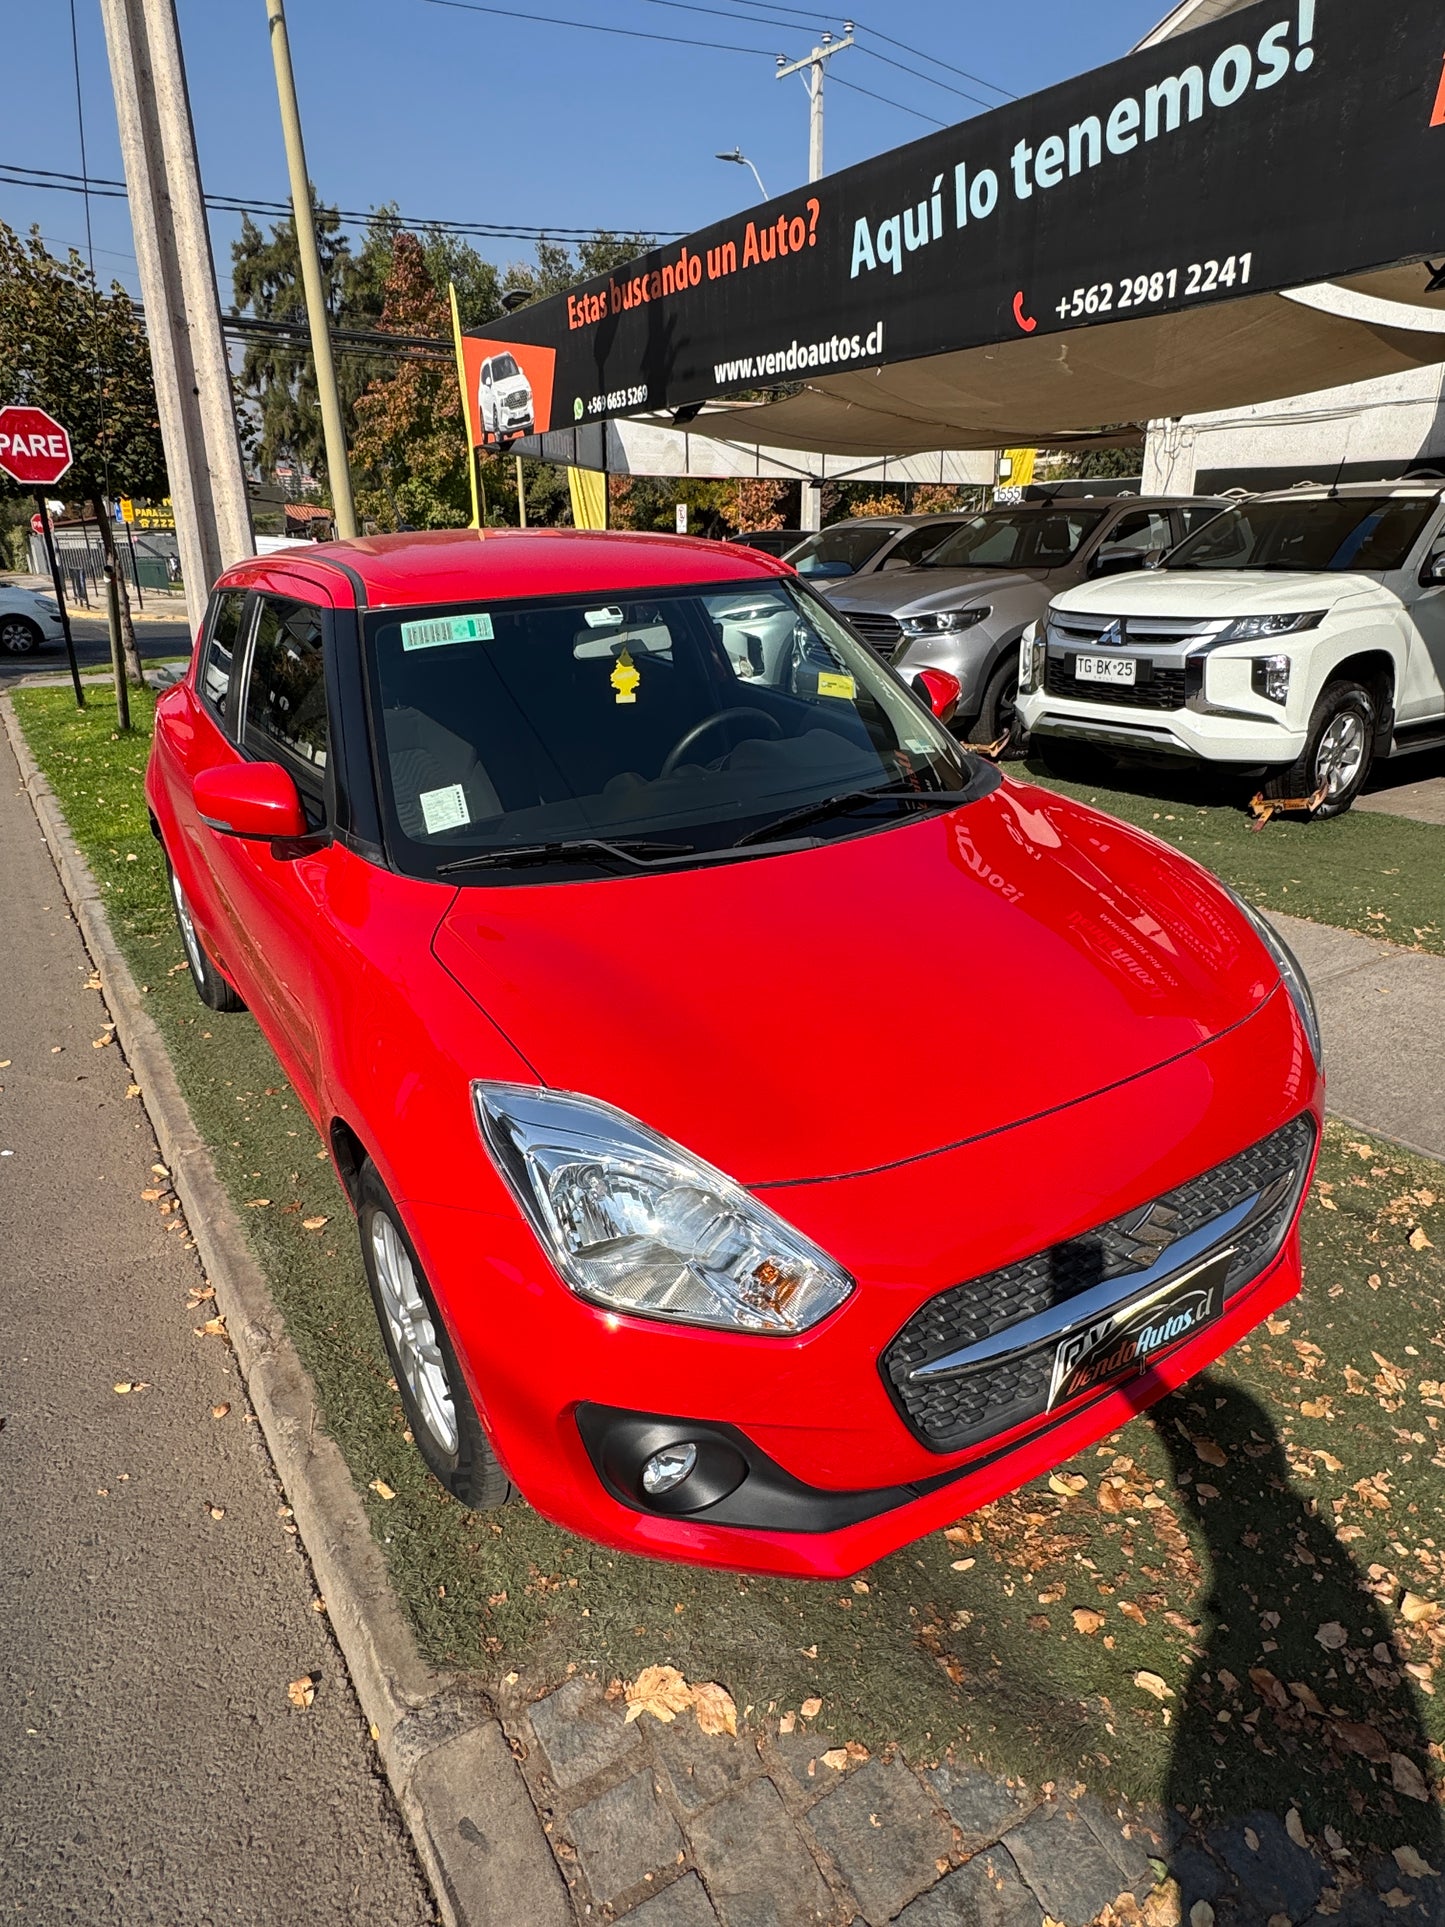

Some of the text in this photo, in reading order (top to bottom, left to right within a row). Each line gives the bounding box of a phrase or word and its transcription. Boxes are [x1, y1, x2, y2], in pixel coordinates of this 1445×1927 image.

[850, 173, 944, 279] Aquí
[955, 161, 999, 230] lo
[1011, 0, 1316, 200] tenemos!
[567, 198, 821, 331] Estas buscando un Auto?
[1055, 252, 1253, 320] +562 2981 2241
[714, 321, 883, 384] www.vendoautos.cl
[587, 384, 648, 414] +569 6653 5269
[0, 433, 66, 458] PARE
[997, 486, 1021, 501] 1555
